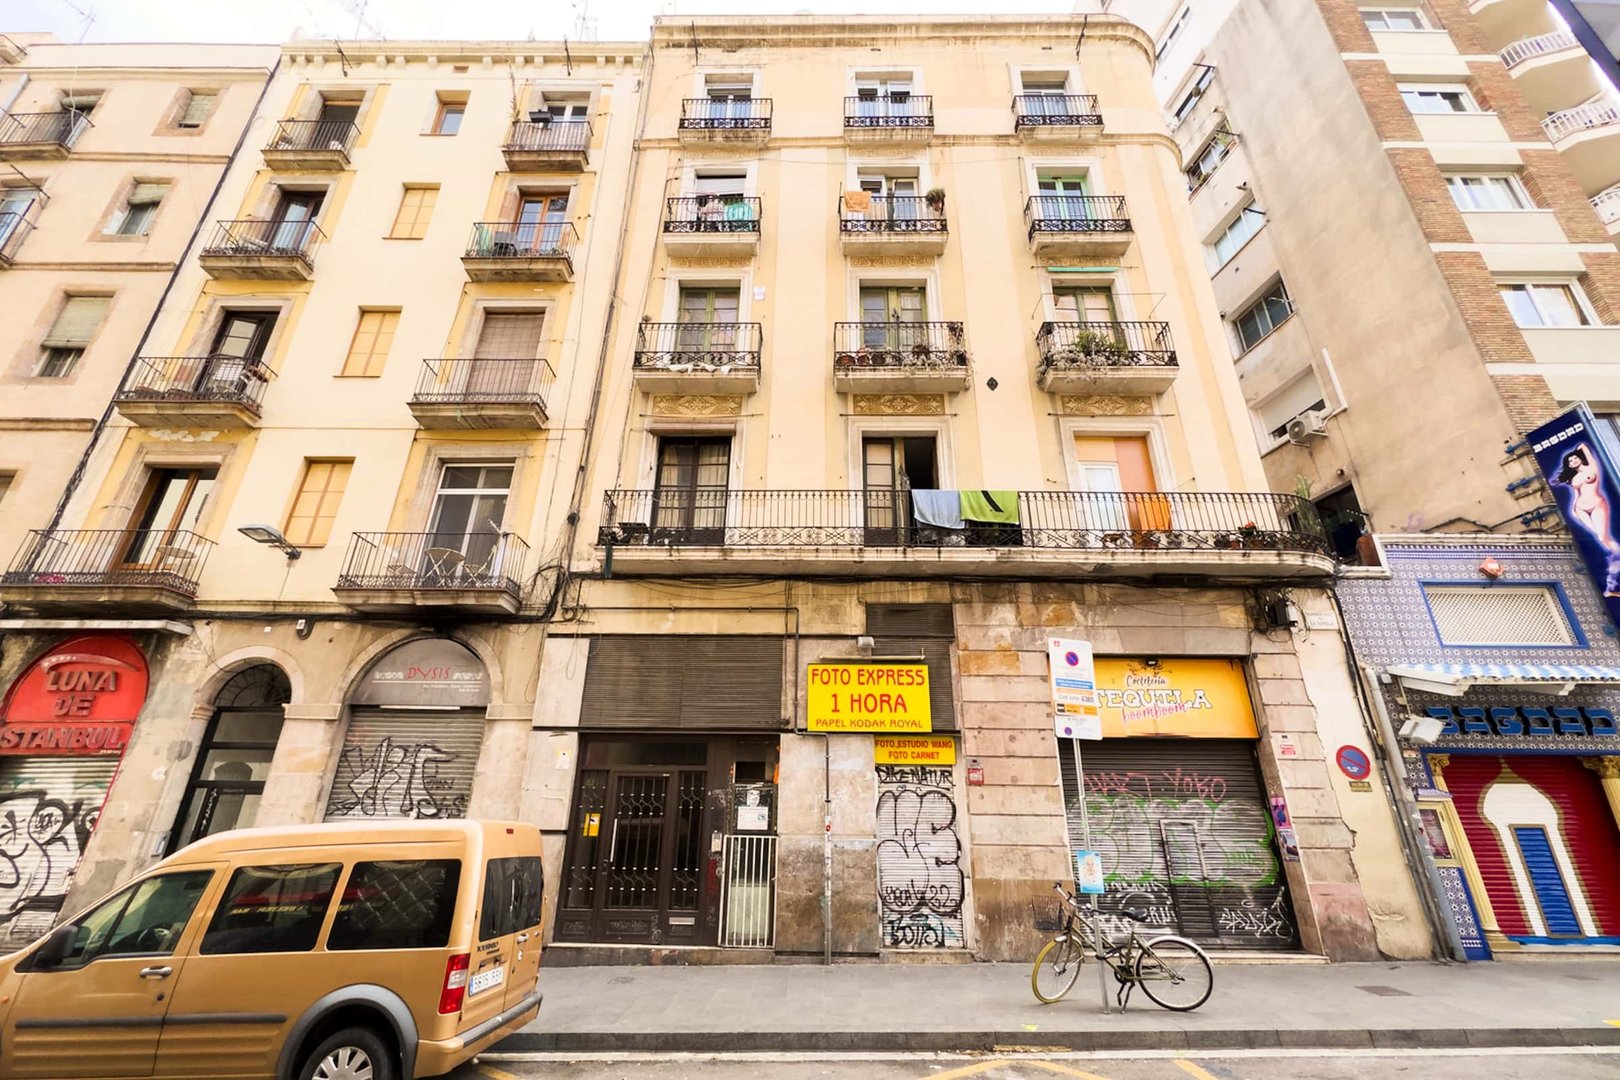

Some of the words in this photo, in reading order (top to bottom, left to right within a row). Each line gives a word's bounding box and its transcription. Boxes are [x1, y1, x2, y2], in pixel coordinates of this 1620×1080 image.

[1533, 422, 1584, 453] BAGDAD
[46, 671, 118, 691] LUNA
[407, 667, 451, 679] DYSIS
[812, 668, 851, 685] FOTO
[857, 669, 925, 686] EXPRESS
[55, 695, 95, 717] DE
[831, 693, 840, 713] 1
[850, 693, 907, 713] HORA
[1094, 689, 1212, 709] TEQUILA
[815, 719, 846, 728] PAPEL
[850, 719, 886, 728] KODAK
[890, 719, 923, 729] ROYAL
[1426, 706, 1617, 736] BAGDAD
[0, 727, 121, 750] STANBUL
[875, 740, 895, 748] FOTO
[897, 740, 929, 749] ESTUDIO
[931, 741, 953, 749] WANG
[888, 751, 908, 759] FOTO
[911, 751, 940, 759] CARNET
